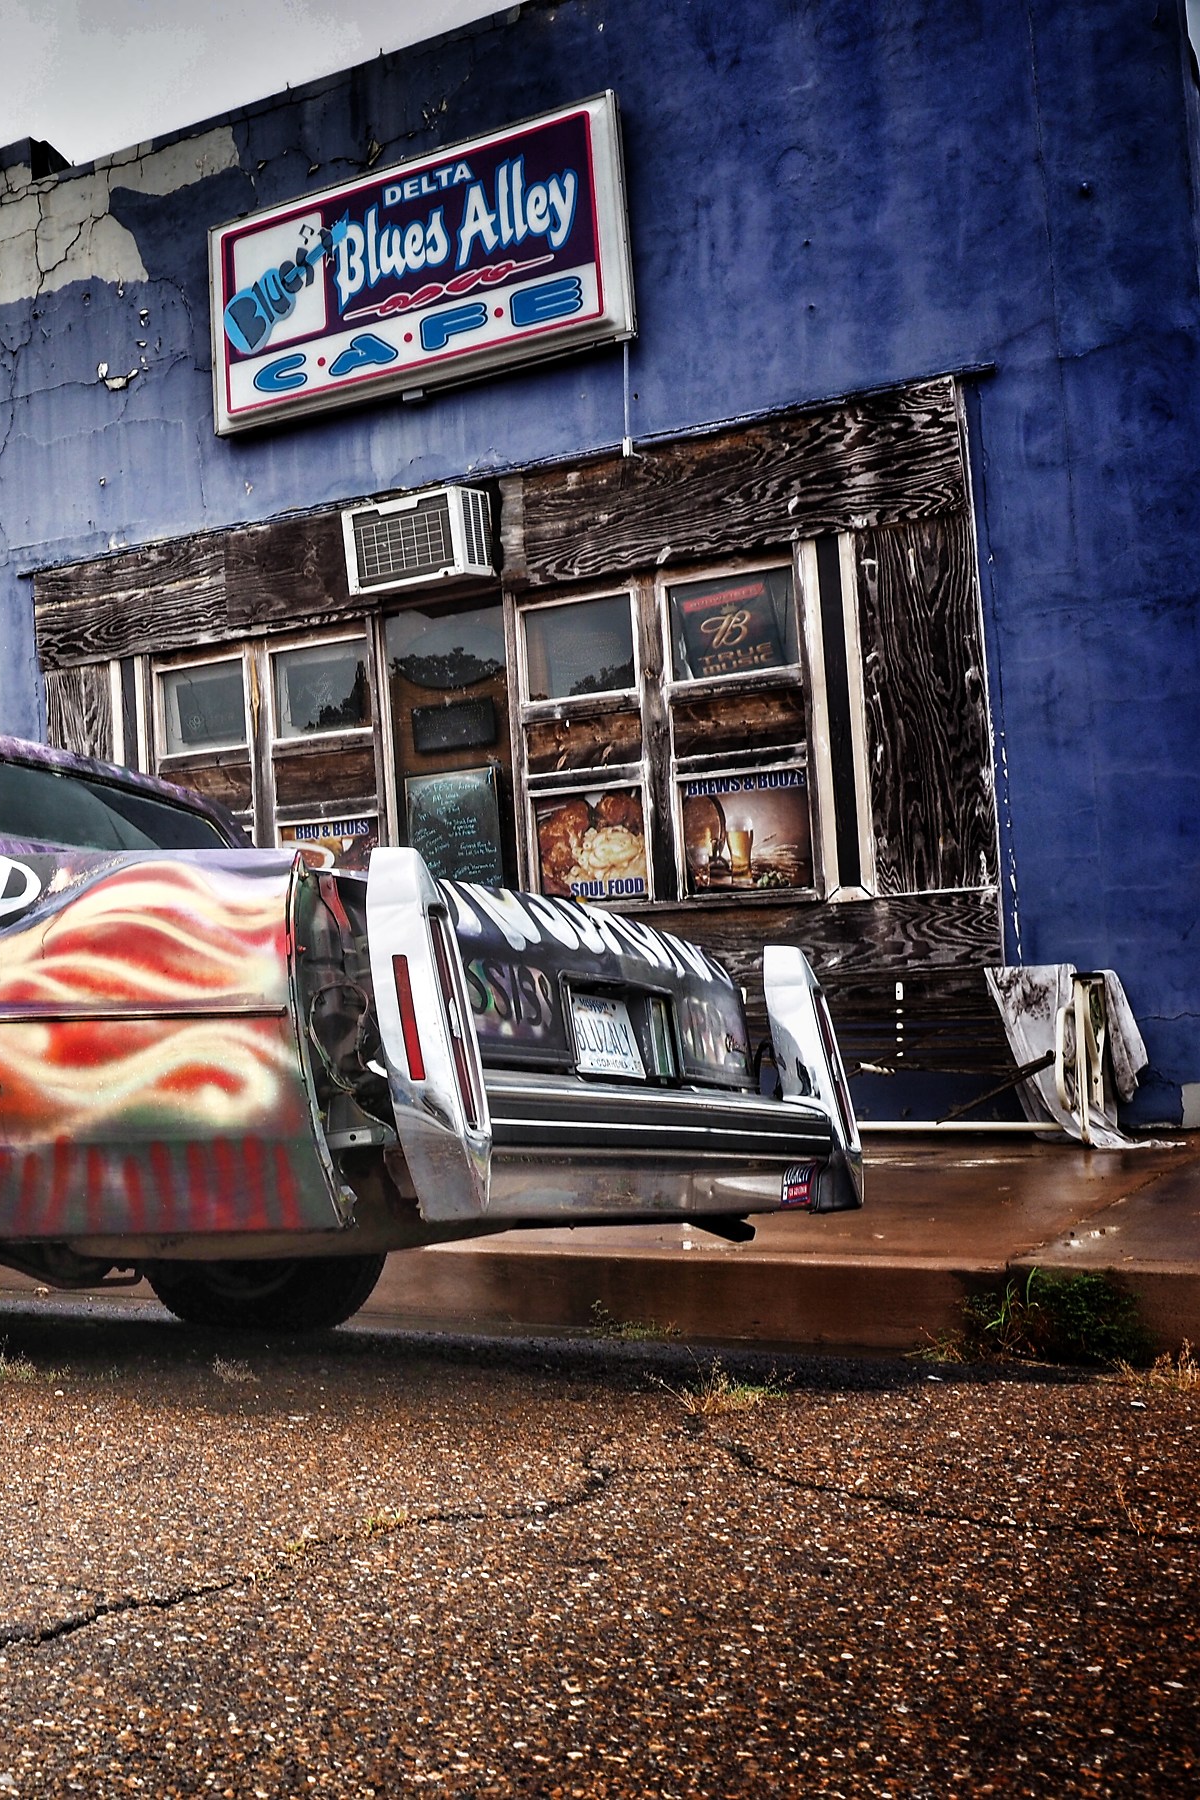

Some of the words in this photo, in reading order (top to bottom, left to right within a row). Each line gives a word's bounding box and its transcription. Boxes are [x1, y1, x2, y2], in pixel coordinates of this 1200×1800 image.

[383, 161, 472, 208] DELTA
[337, 207, 448, 308] Blues
[457, 156, 576, 268] Alley
[686, 778, 741, 797] BREWS
[743, 775, 755, 791] &
[295, 824, 320, 840] BBQ
[321, 824, 331, 837] &
[332, 820, 370, 836] BLUES
[570, 881, 606, 898] SOUL
[607, 877, 645, 895] FOOD
[574, 1017, 634, 1058] BLUZALY
